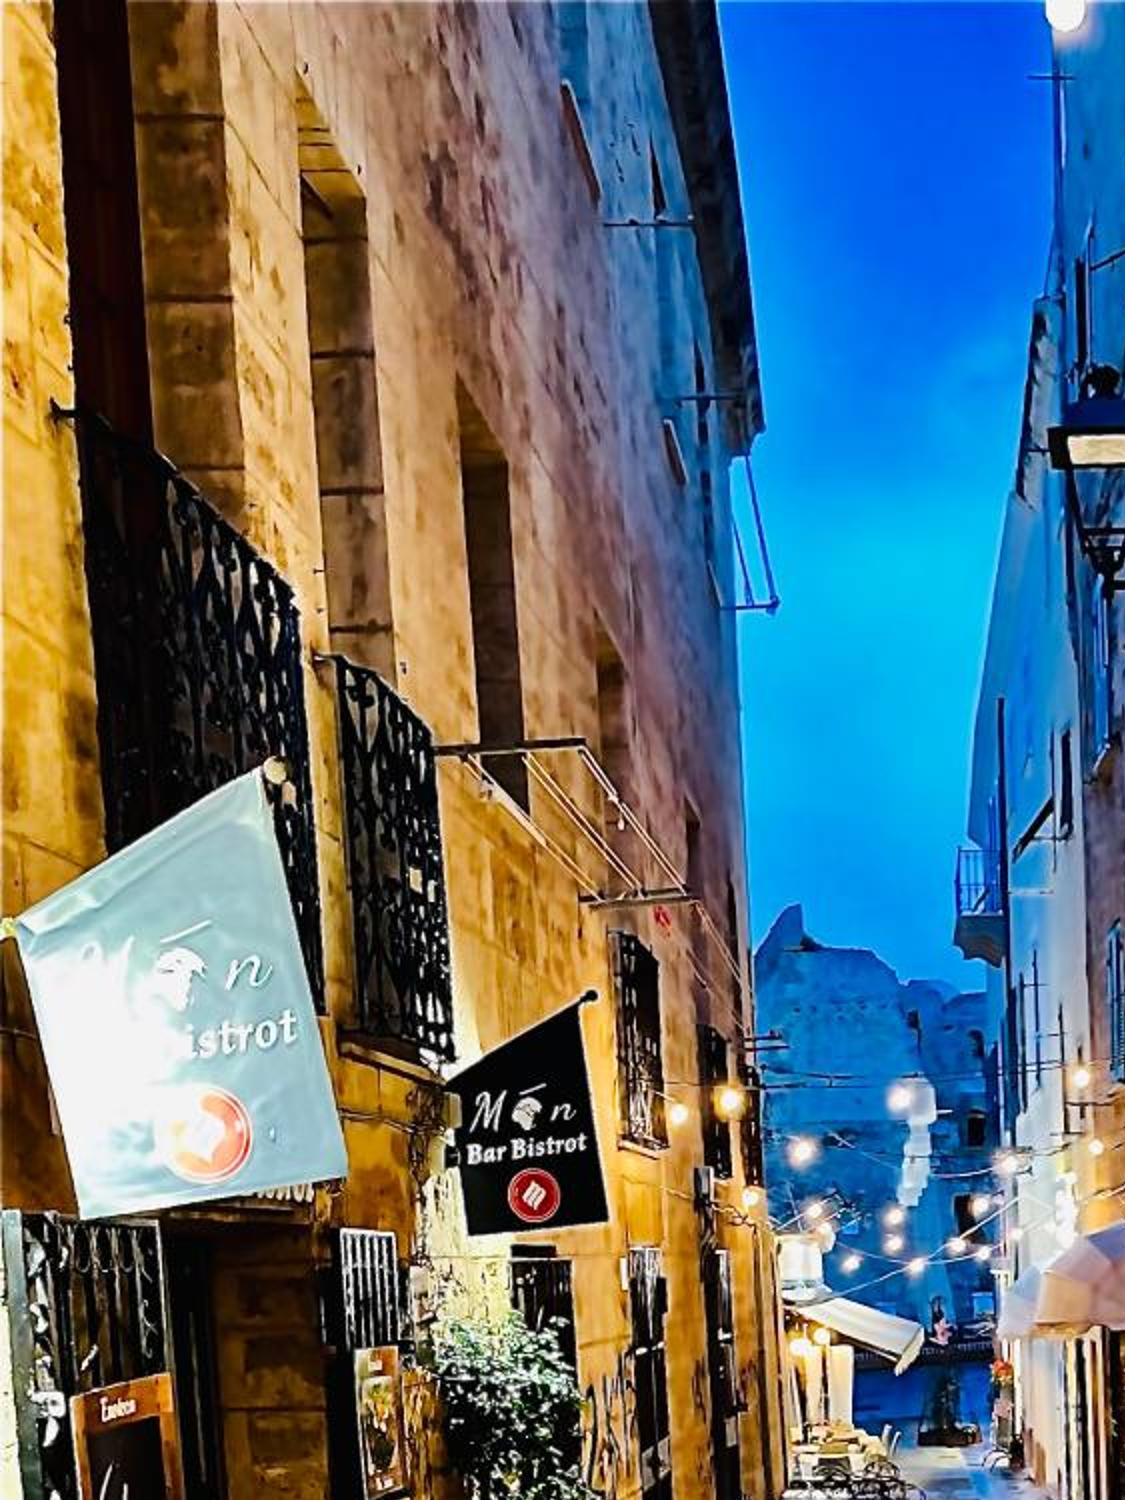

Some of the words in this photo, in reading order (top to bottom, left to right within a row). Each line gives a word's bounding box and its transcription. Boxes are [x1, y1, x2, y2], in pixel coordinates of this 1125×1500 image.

[184, 1007, 298, 1061] istrot
[466, 1143, 507, 1165] Bar
[510, 1132, 588, 1160] Bistrot
